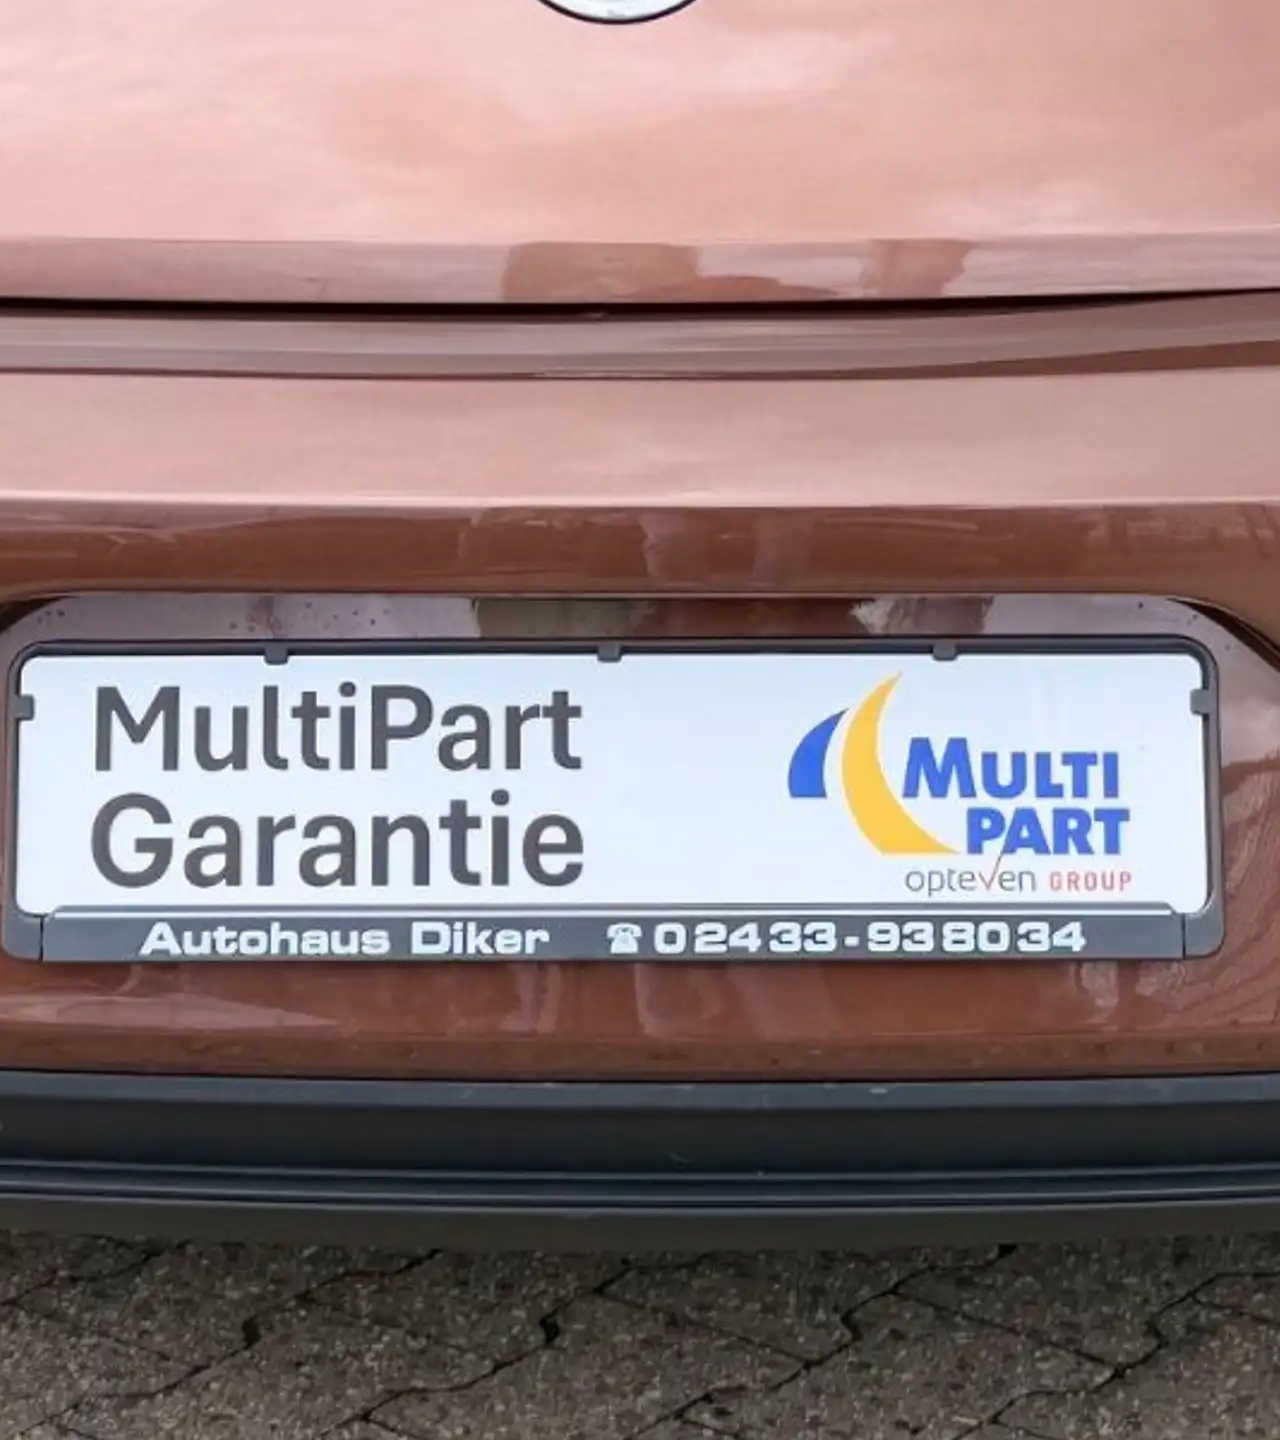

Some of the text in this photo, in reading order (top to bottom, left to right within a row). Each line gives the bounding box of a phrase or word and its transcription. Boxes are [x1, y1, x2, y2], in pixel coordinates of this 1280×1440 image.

[94, 681, 583, 772] MultiPart
[902, 736, 1120, 800] MULTI
[91, 789, 585, 889] Garantie
[966, 806, 1131, 856] PART
[904, 857, 1133, 897] opteven GROUP
[139, 921, 392, 956] Autohaus
[410, 921, 550, 956] Diker
